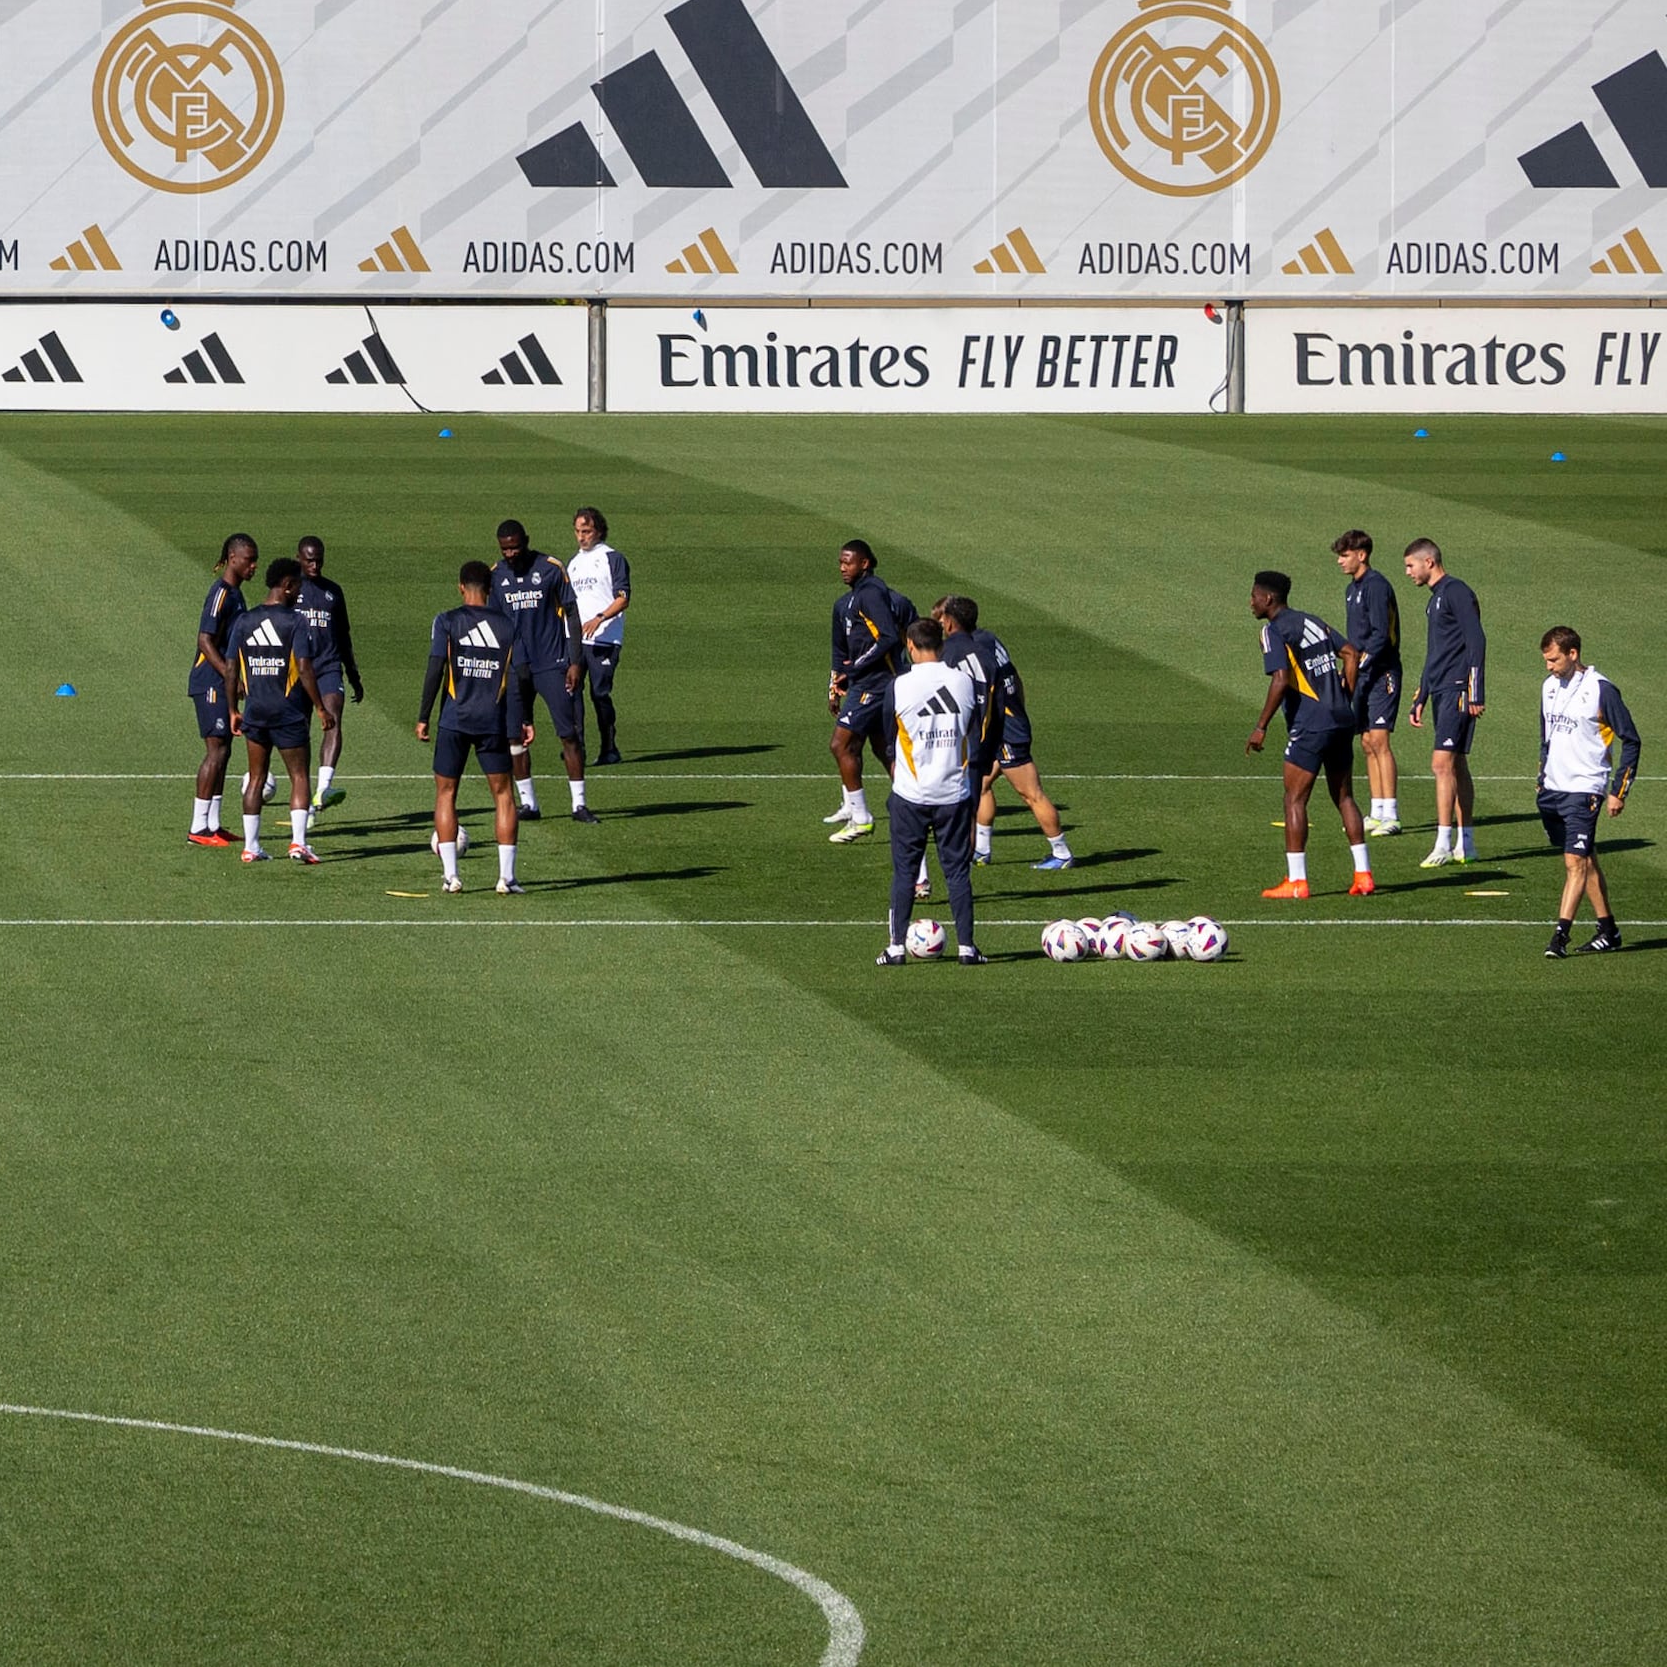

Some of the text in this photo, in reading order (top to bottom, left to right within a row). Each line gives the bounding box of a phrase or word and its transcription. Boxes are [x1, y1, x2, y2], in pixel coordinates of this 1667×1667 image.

[154, 240, 327, 273] ADIDAS.COM
[463, 241, 634, 274] ADIDAS.COM
[770, 242, 942, 275] ADIDAS.COM
[1079, 243, 1250, 276] ADIDAS.COM
[1387, 243, 1559, 275] ADIDAS.COM
[660, 332, 1179, 389] Emirates FLY BETTER
[1295, 331, 1662, 386] Emirates FLY
[457, 656, 500, 671] Emirates
